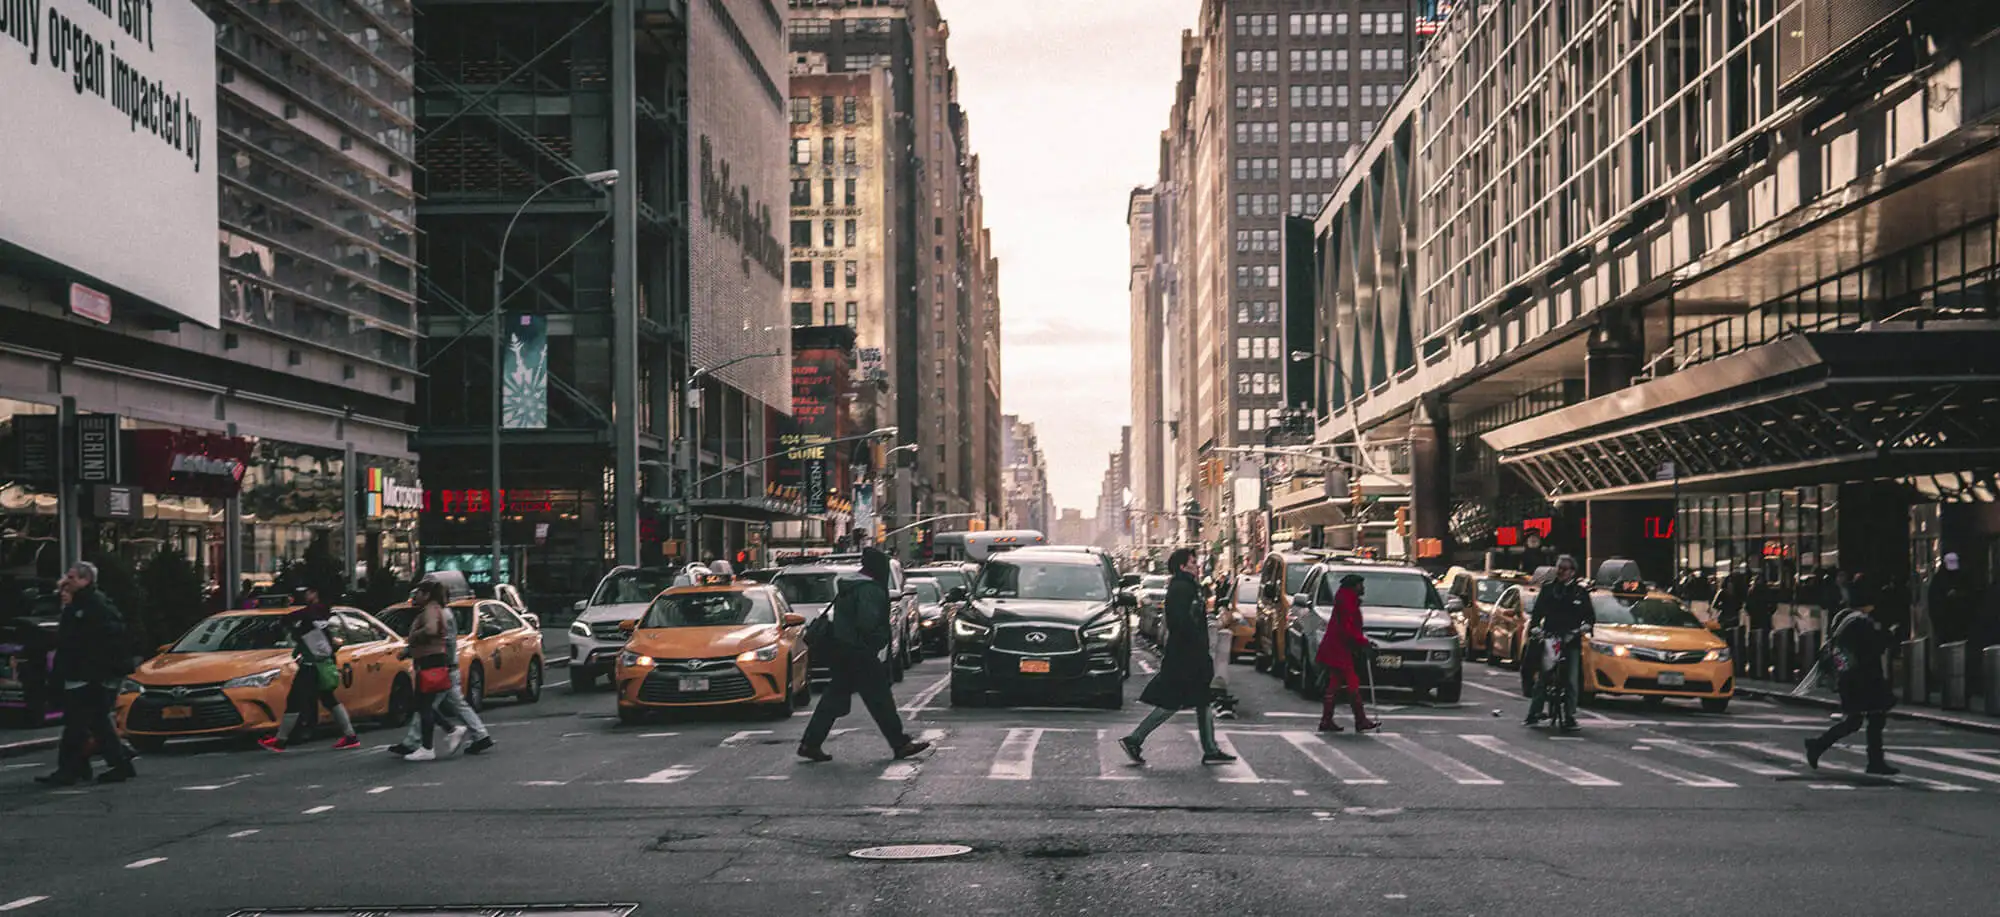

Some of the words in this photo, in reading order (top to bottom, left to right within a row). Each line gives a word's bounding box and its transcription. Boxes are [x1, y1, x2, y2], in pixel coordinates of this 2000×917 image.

[119, 0, 154, 52] snt
[49, 7, 105, 100] organ
[111, 39, 182, 151] impacted
[185, 97, 201, 173] by
[83, 432, 105, 480] GRIND
[383, 476, 424, 509] Microsoft
